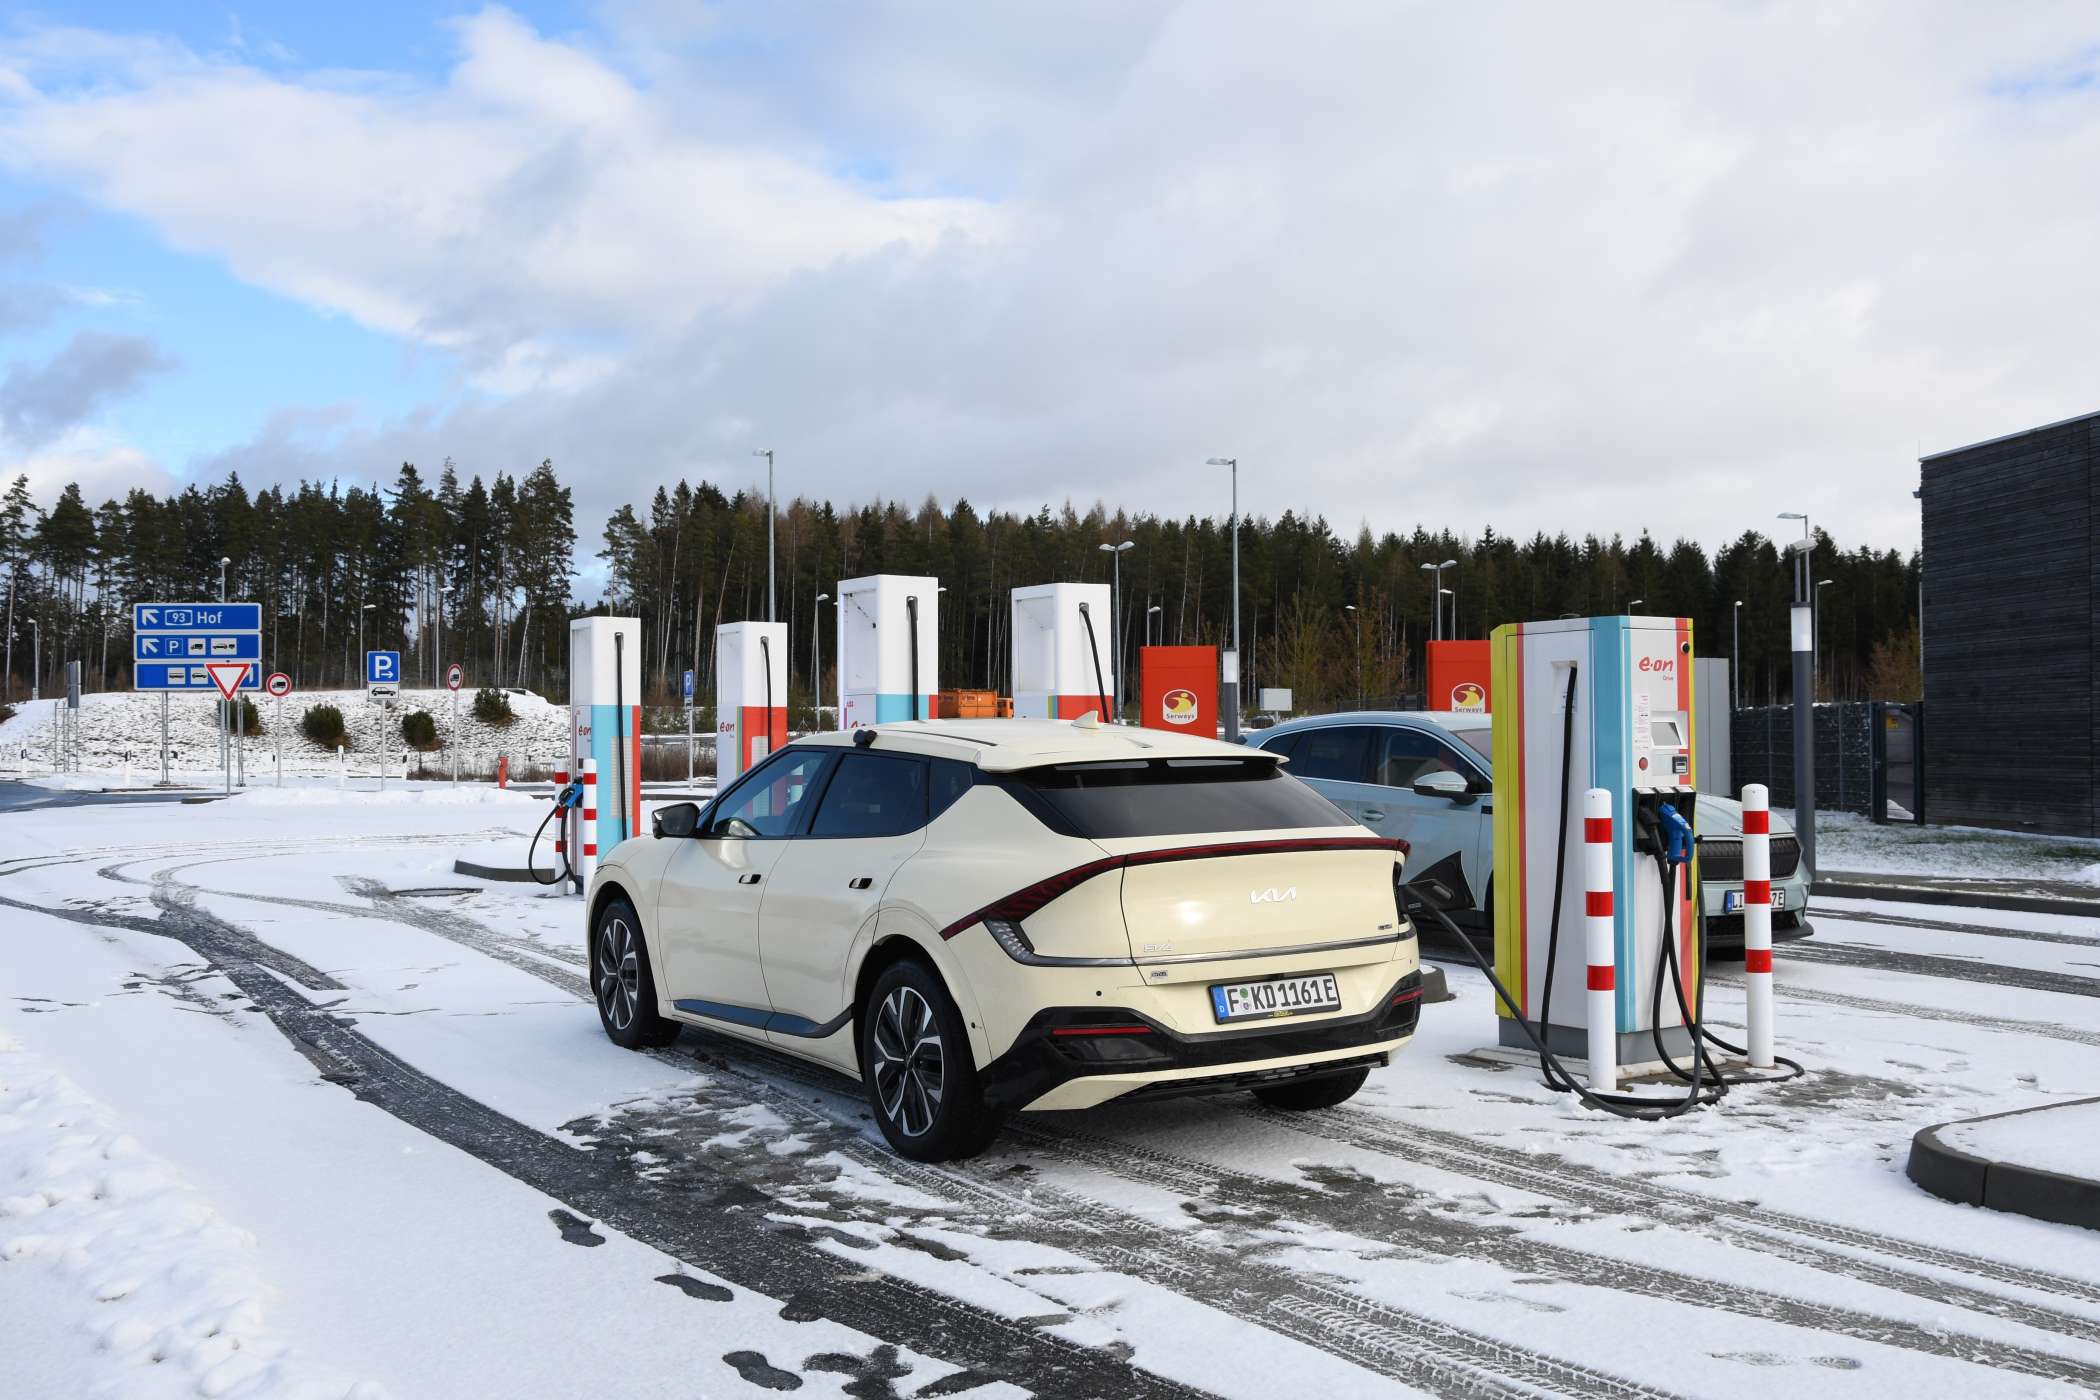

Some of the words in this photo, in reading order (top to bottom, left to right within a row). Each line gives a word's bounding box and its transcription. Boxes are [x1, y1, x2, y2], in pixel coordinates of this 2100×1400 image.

[172, 612, 185, 622] 93
[197, 611, 223, 623] Hof
[169, 640, 179, 653] P
[375, 655, 392, 678] P
[1226, 988, 1240, 1013] F
